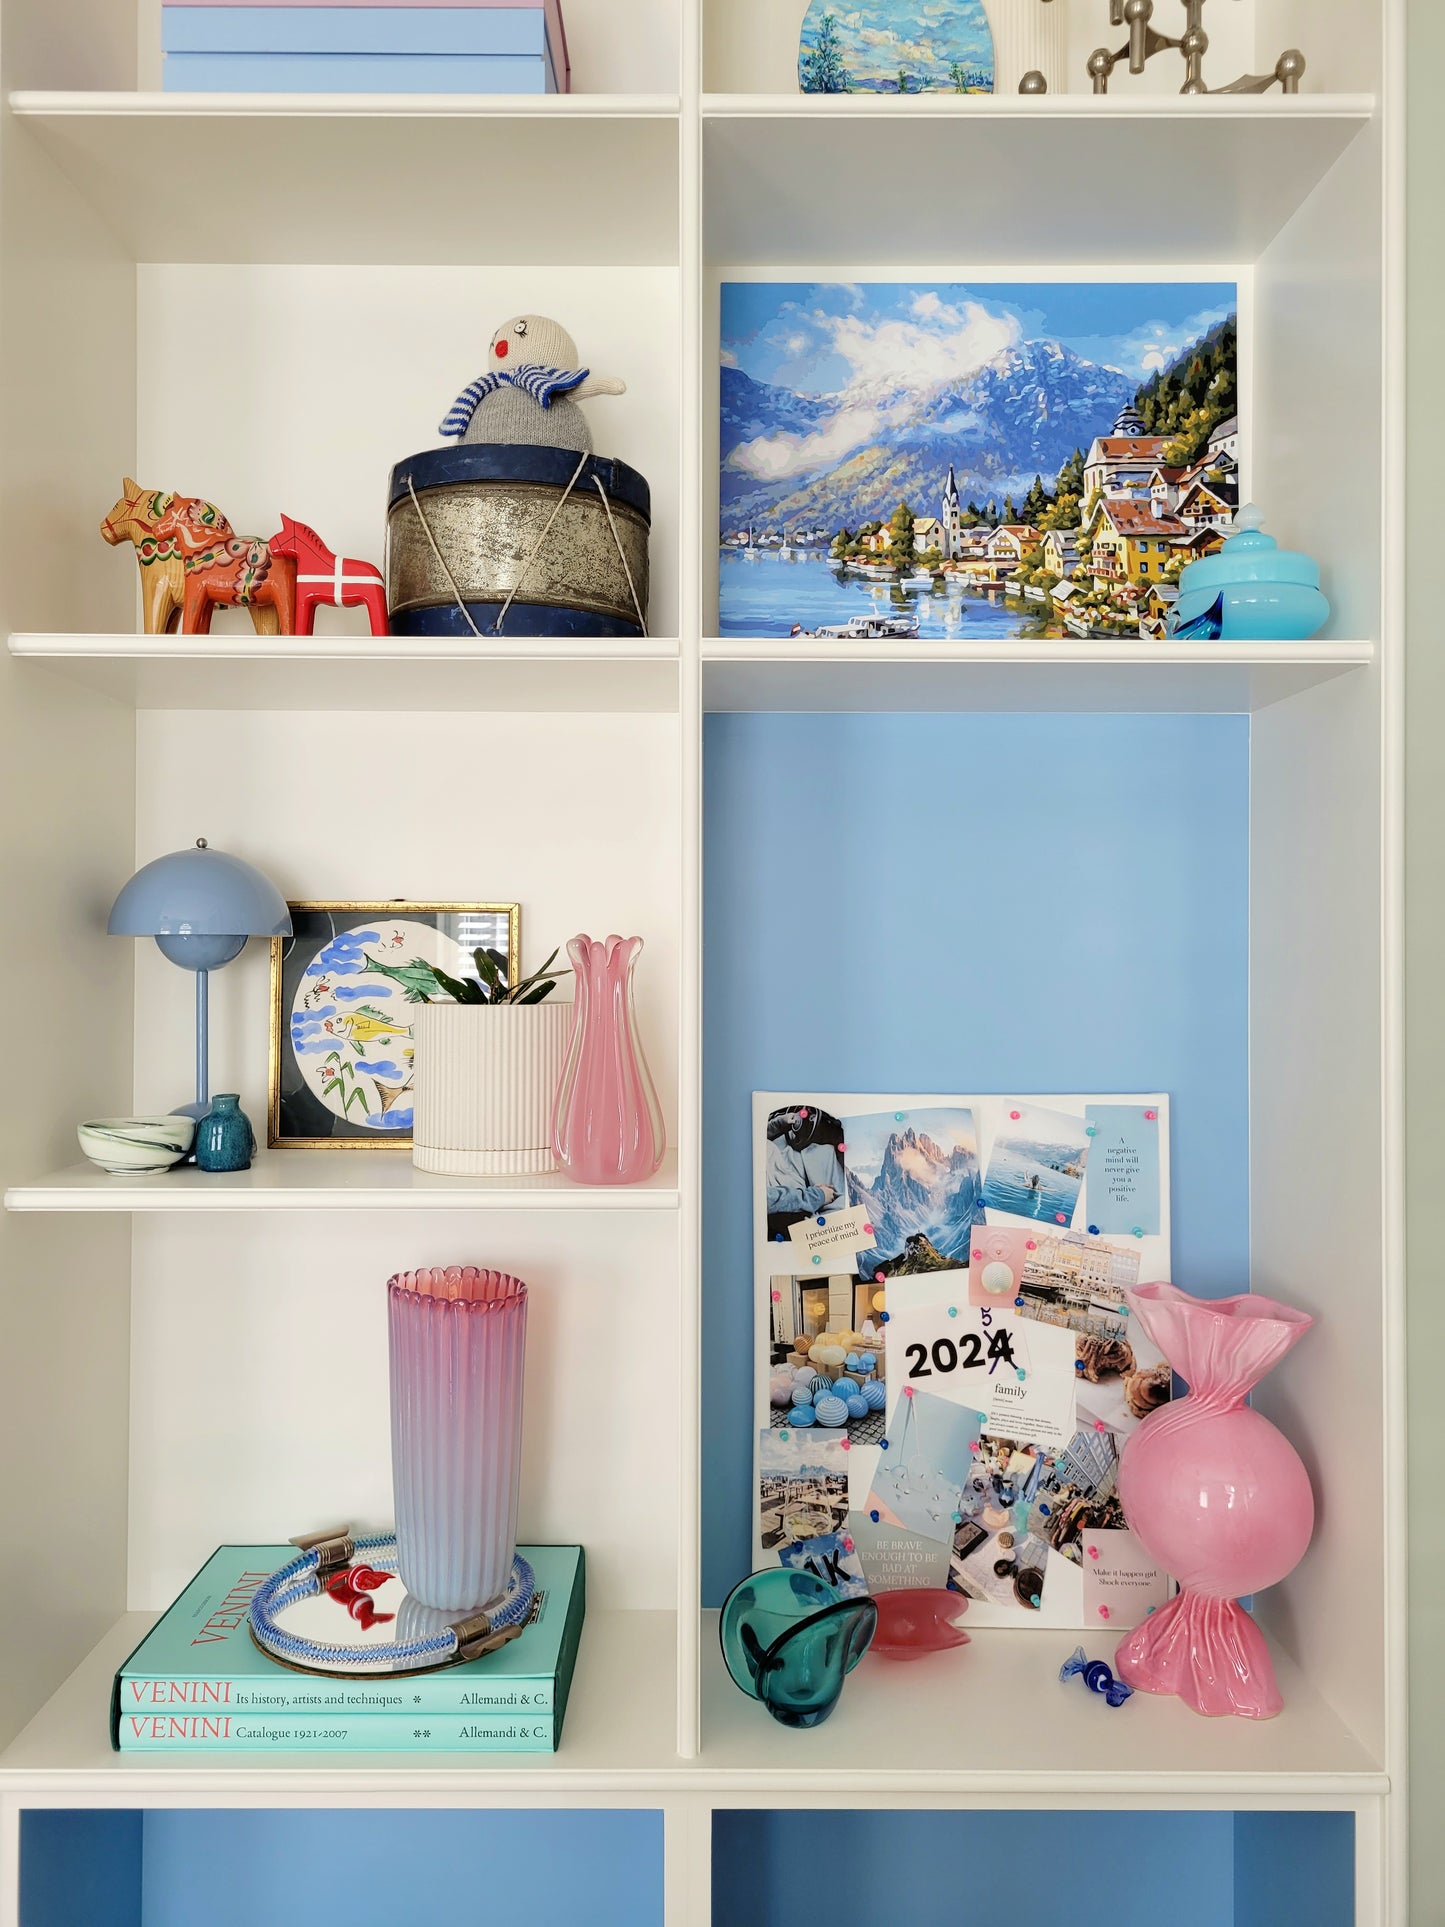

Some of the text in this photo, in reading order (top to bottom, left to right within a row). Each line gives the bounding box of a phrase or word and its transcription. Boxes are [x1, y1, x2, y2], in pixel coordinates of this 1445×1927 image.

[1107, 1146, 1137, 1155] negative
[1125, 1165, 1140, 1175] give
[1108, 1185, 1137, 1194] positive
[1115, 1194, 1129, 1202] life.
[810, 1225, 843, 1241] prioritize
[844, 1221, 856, 1230] my
[808, 1228, 859, 1250] peace of mind
[980, 1307, 993, 1326] 5
[995, 1383, 1028, 1399] family
[876, 1540, 923, 1550] BE BRAVE
[861, 1551, 937, 1563] ENOUGH TO BE
[882, 1563, 918, 1574] BAD AT
[1093, 1568, 1111, 1576] Make
[1119, 1570, 1144, 1578] happen
[868, 1575, 931, 1586] SOMETHING
[190, 1571, 271, 1646] VENINI
[129, 1681, 548, 1708] VENINI Its history, artists and techniques Allemandi & C.
[129, 1716, 548, 1741] VENINI Catalogue 1921-2007 Allemandi & C.
